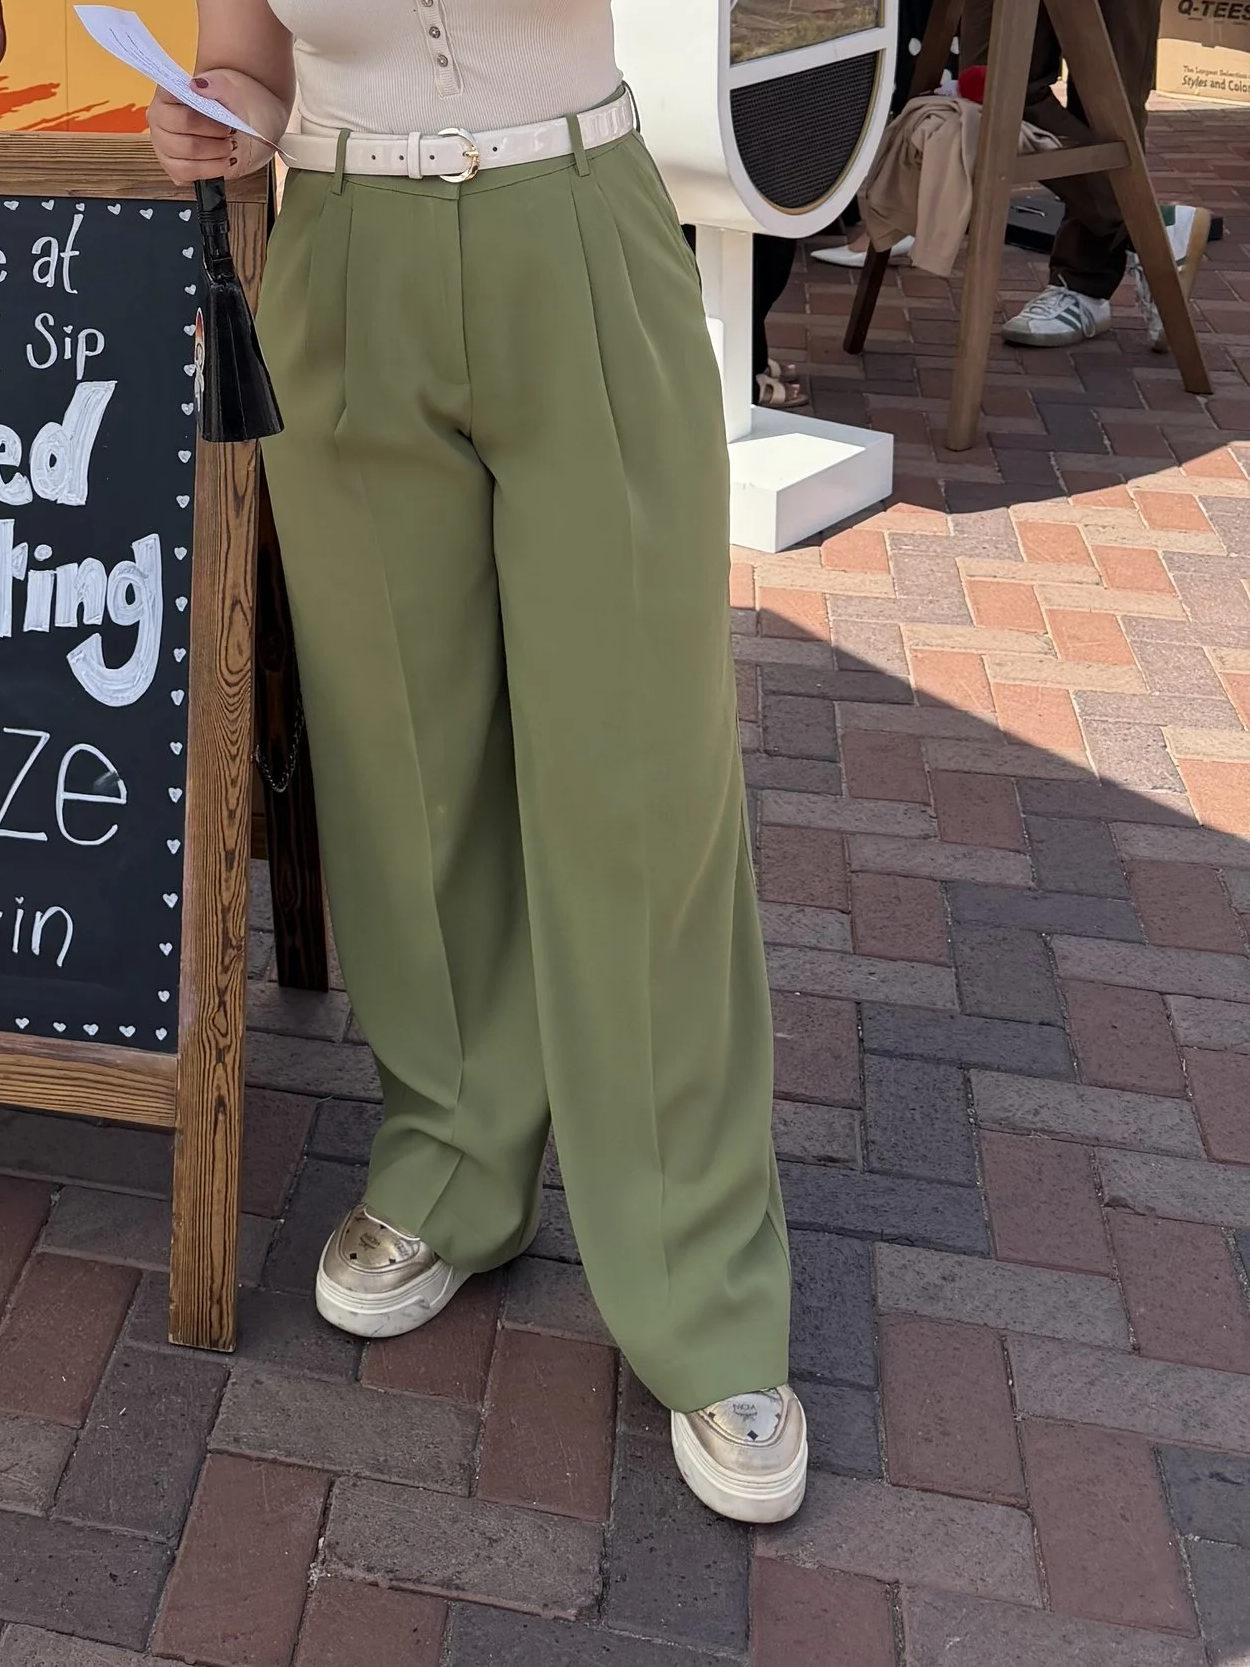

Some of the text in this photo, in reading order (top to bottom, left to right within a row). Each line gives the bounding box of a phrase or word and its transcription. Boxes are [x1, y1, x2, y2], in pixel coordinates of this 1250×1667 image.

[1182, 75, 1208, 89] Styles
[1209, 79, 1226, 90] and
[32, 213, 84, 294] at
